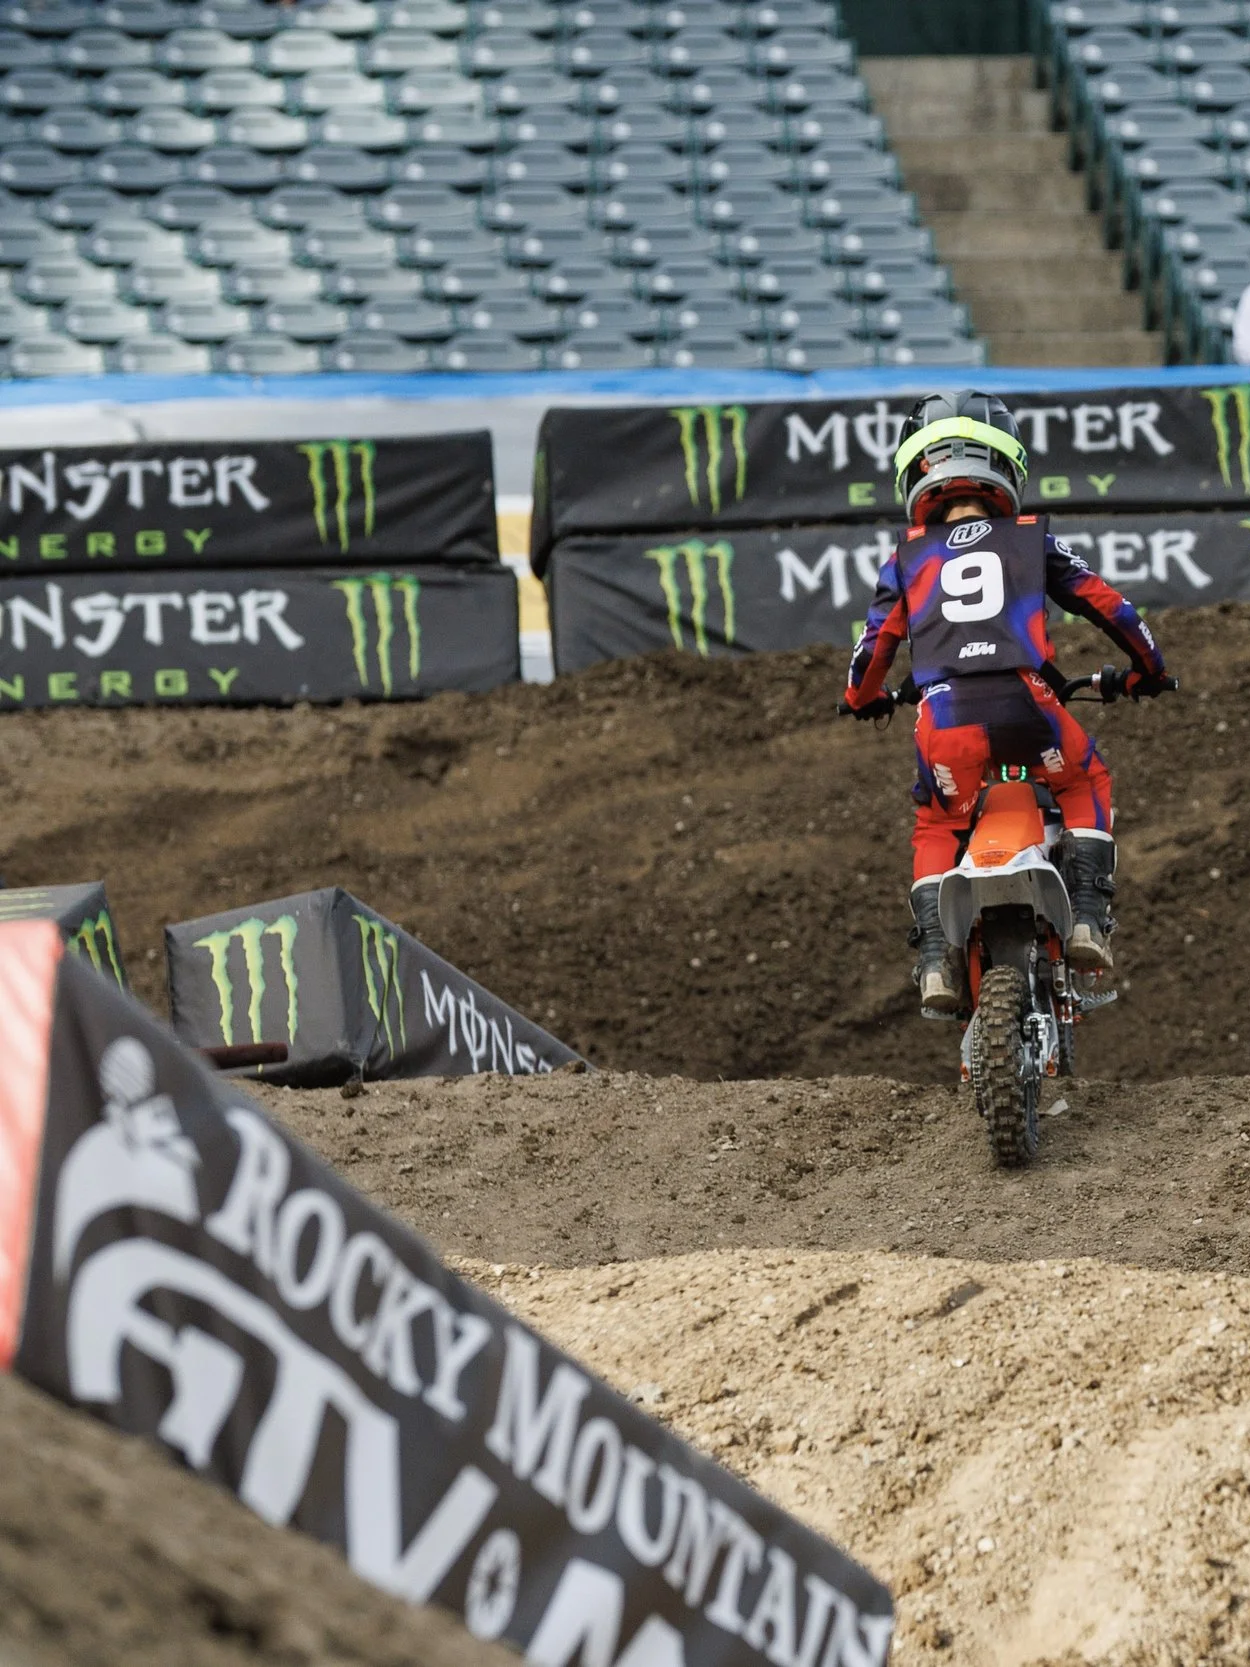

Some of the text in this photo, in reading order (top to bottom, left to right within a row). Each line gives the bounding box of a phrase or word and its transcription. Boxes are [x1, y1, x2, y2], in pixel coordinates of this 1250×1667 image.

[785, 401, 1175, 472] MOTER
[0, 451, 271, 520] NSTER
[848, 473, 1118, 507] EGY
[776, 528, 1214, 611] MOER
[940, 551, 1005, 623] 9
[0, 582, 304, 657] NSTER
[958, 642, 997, 659] KTM
[205, 1108, 492, 1423] ROCKY
[66, 1236, 500, 1603] ATV
